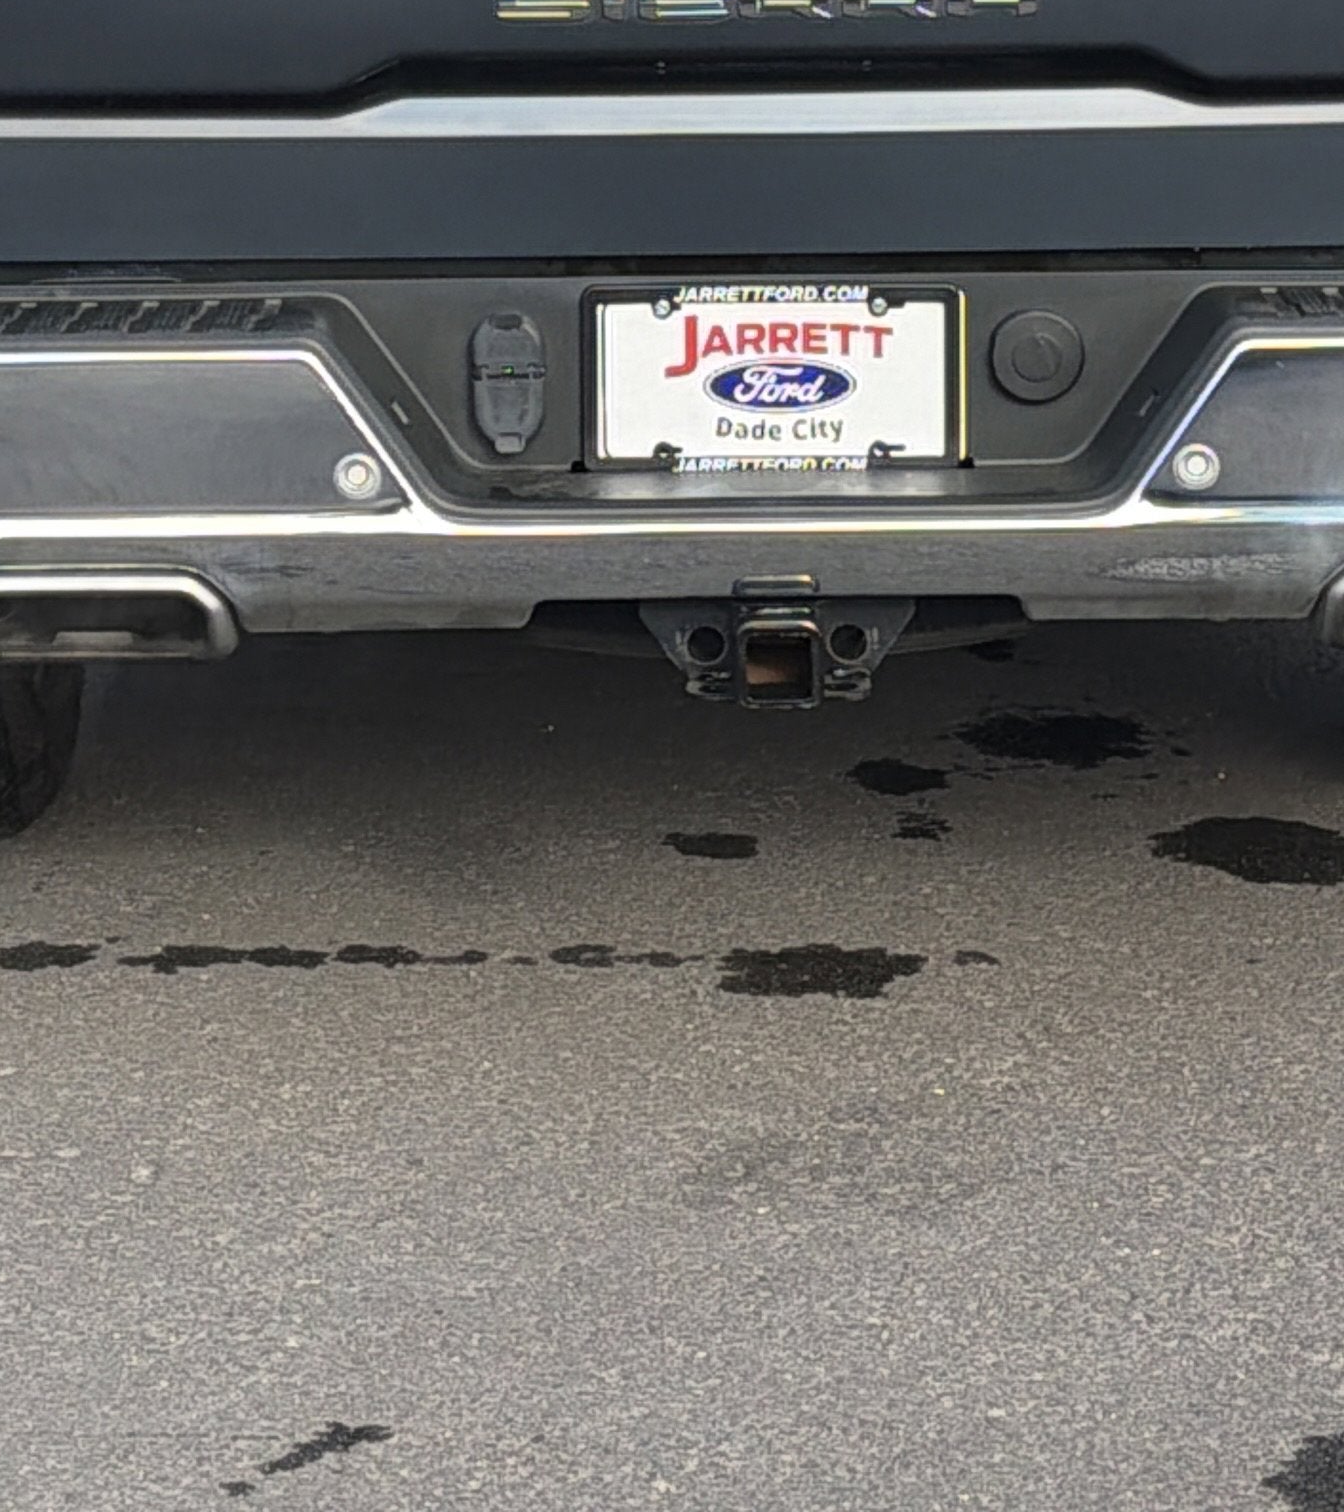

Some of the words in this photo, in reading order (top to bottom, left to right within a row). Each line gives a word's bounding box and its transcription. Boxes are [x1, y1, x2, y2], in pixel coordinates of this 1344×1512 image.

[674, 285, 870, 303] JARRETTFORD.COM
[664, 315, 894, 378] JARRETT
[734, 365, 825, 404] Ford
[715, 417, 783, 442] Dade
[792, 416, 844, 442] City
[672, 457, 868, 473] JARRETTFORDCOM
